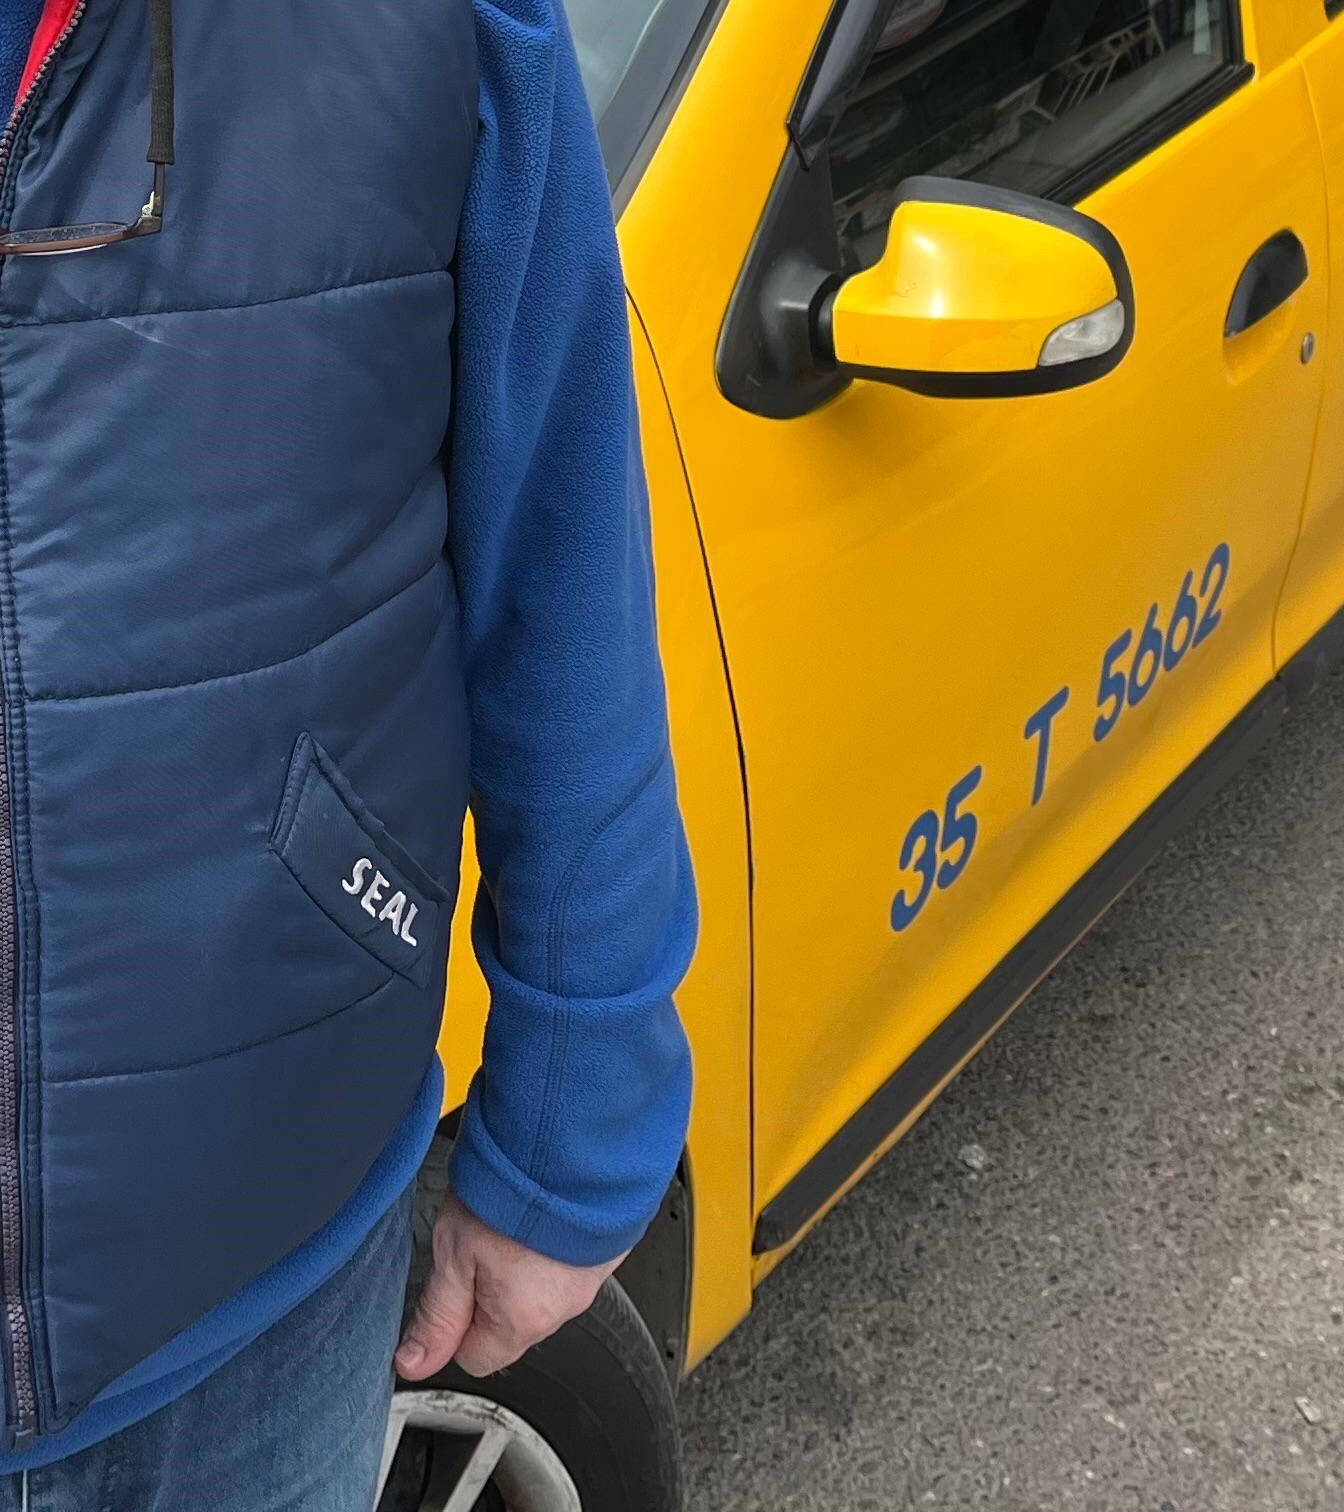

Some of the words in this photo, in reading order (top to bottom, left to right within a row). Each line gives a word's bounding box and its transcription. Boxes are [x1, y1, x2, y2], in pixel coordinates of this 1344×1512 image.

[890, 764, 982, 932] 35
[1024, 686, 1069, 807] T
[1093, 542, 1230, 742] 5662
[341, 858, 418, 946] SEAL
